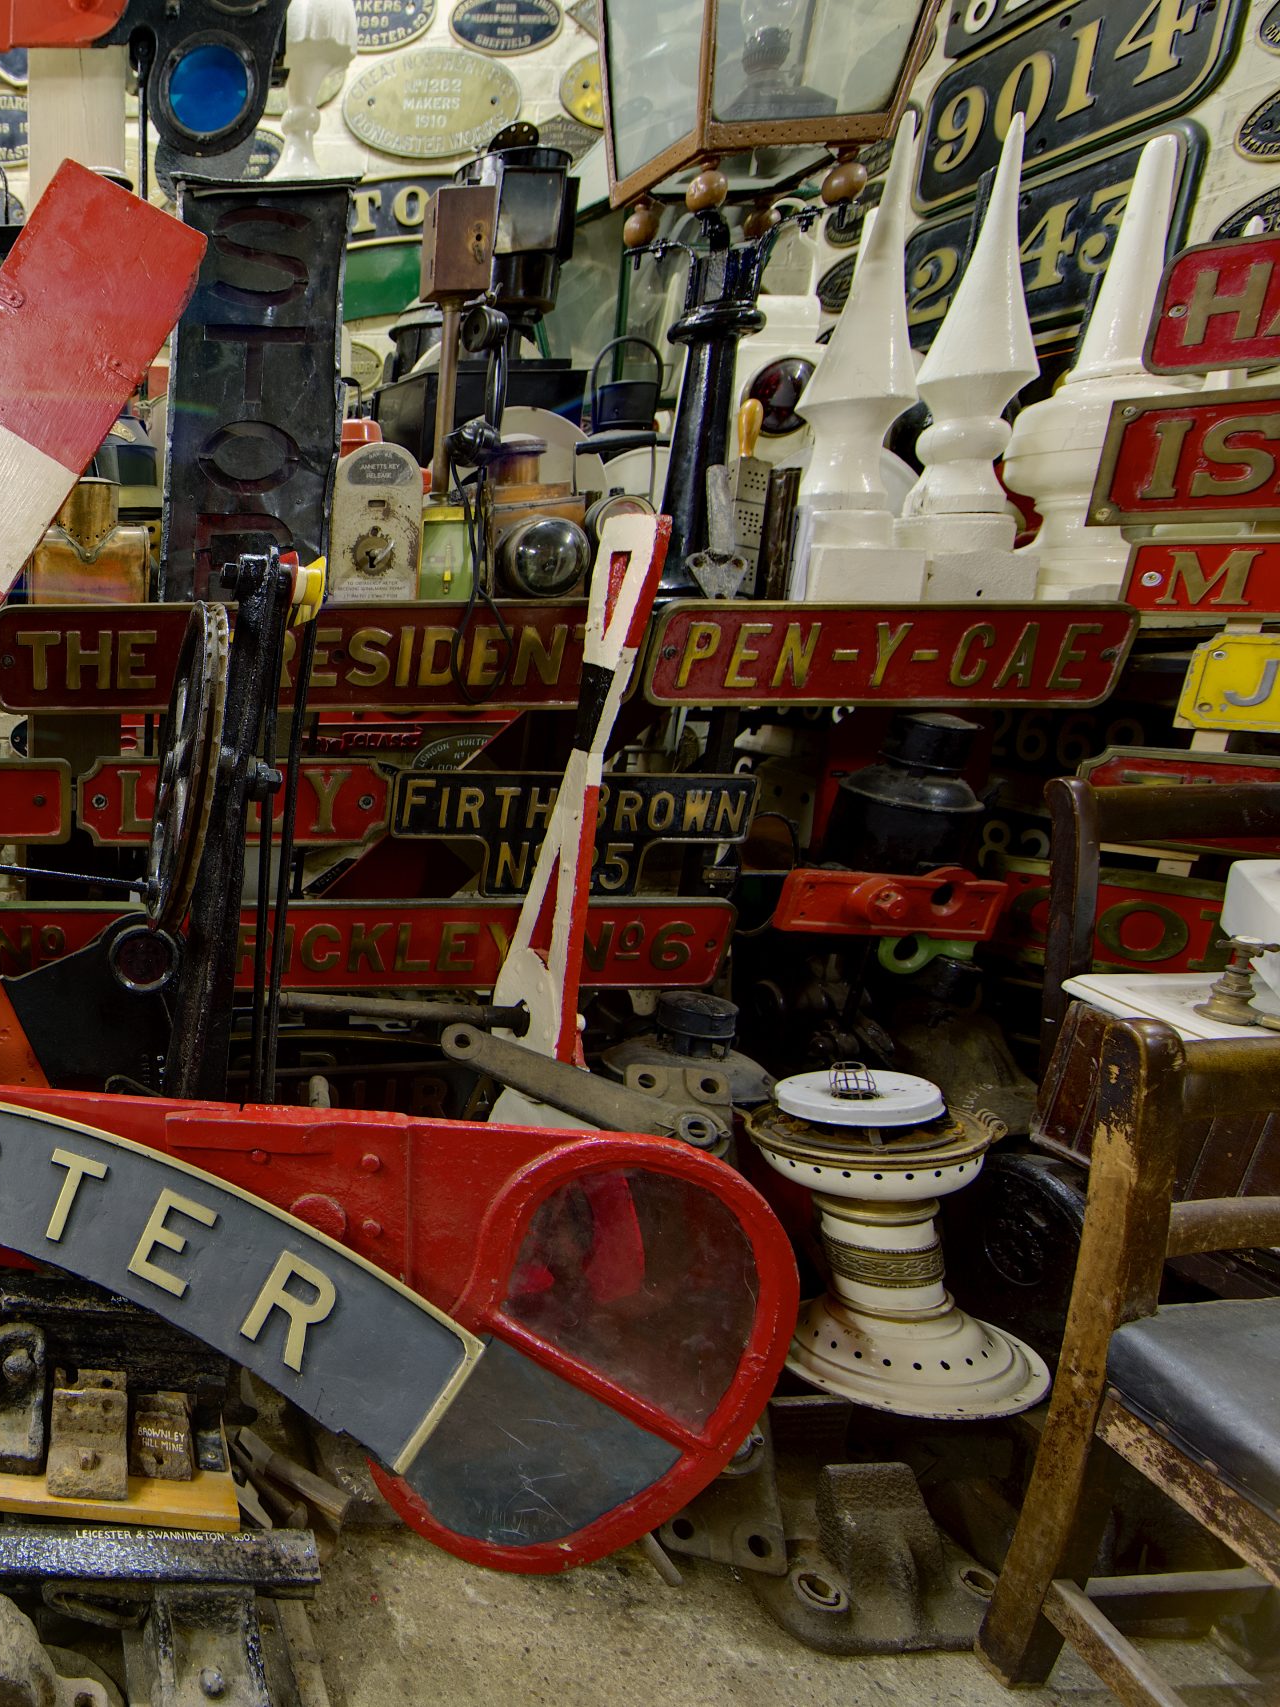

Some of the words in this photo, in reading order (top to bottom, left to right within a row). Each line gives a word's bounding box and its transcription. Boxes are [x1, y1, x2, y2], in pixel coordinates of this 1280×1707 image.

[357, 30, 407, 45] CASTER
[475, 34, 531, 49] SHEFFIELD
[933, 0, 1200, 173] 9014
[403, 97, 461, 110] MAKERS
[415, 115, 448, 128] 1910
[16, 630, 157, 690] THE
[675, 620, 1104, 690] PEN-Y-CAE
[418, 742, 451, 769] LONDON
[401, 778, 558, 830] FIRTH
[137, 1426, 186, 1443] BROWNLEY
[142, 1437, 160, 1449] HILL
[161, 1440, 185, 1454] MINE
[75, 1530, 133, 1541] LEICESTER
[136, 1530, 145, 1540] &
[146, 1531, 226, 1542] SWANNINGTON
